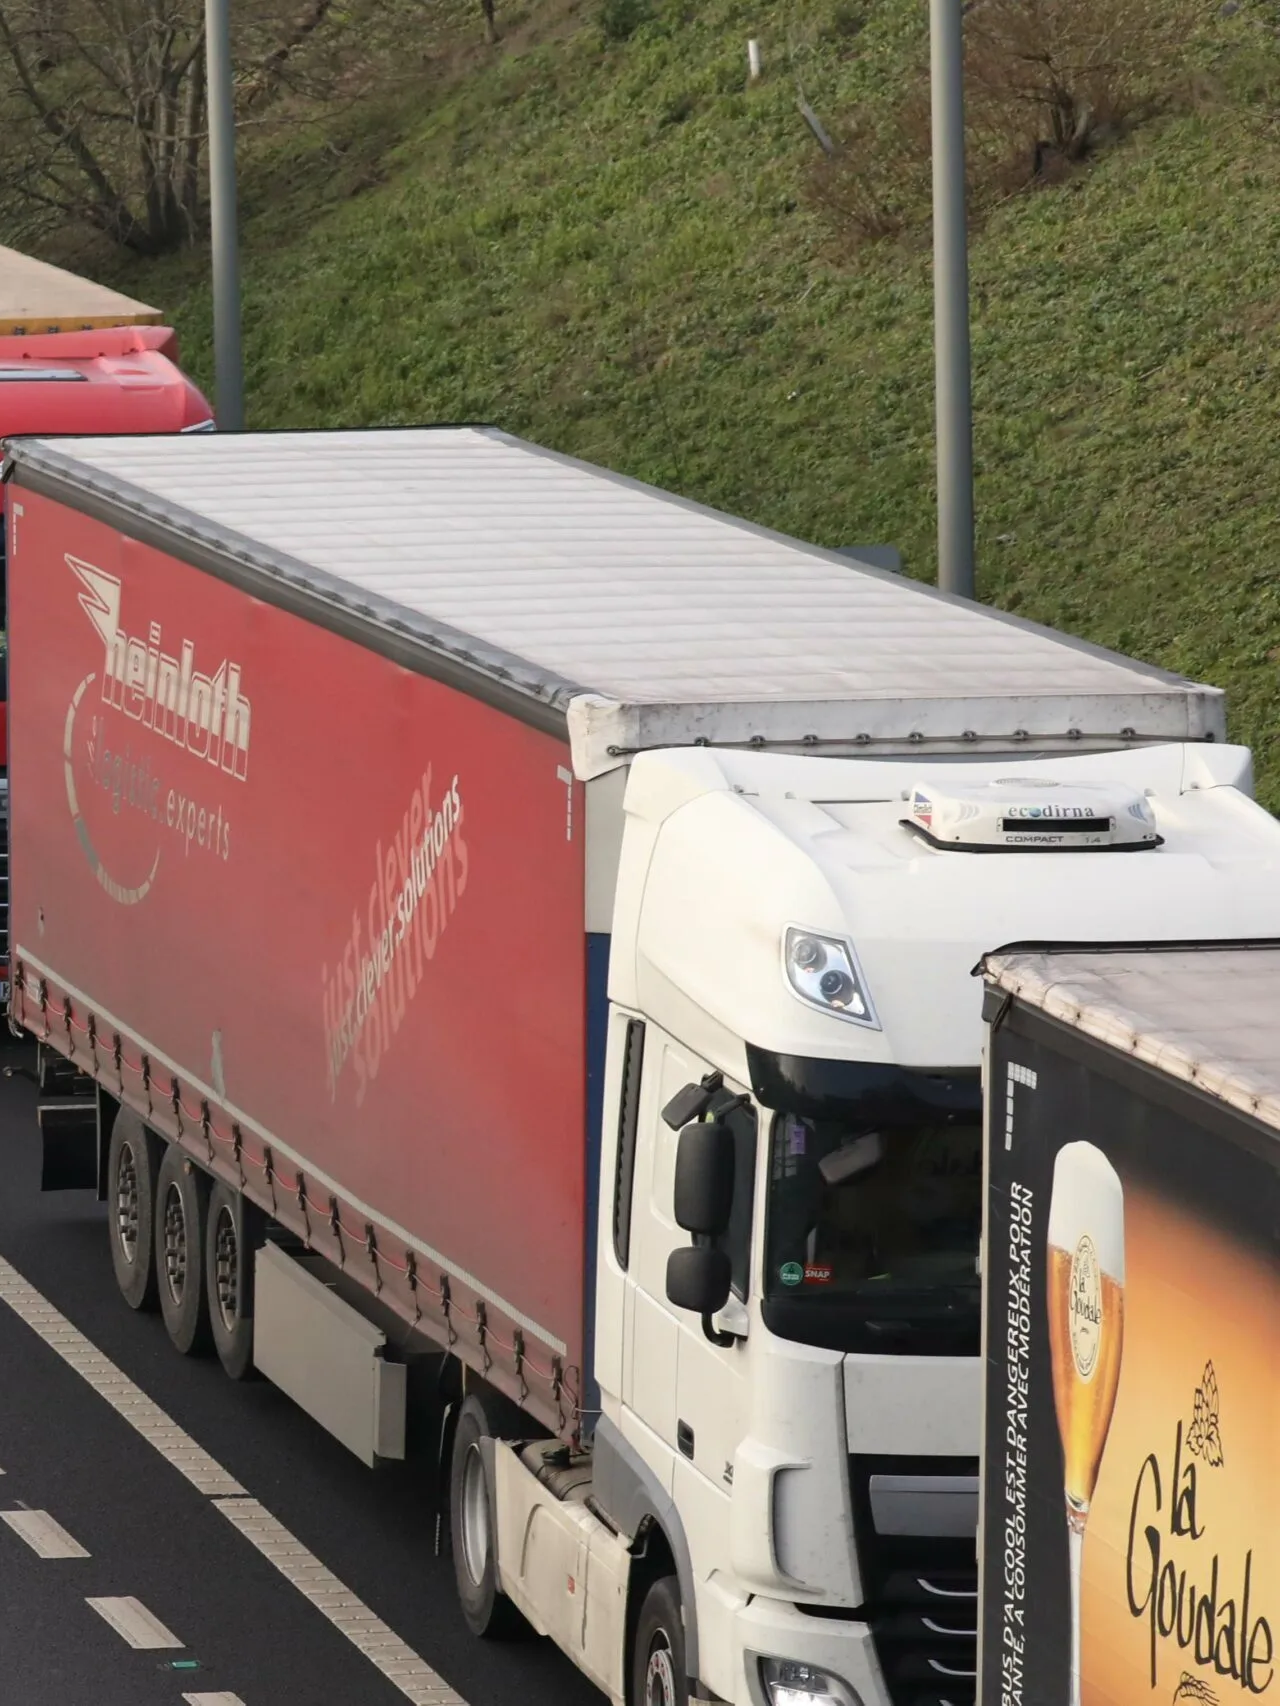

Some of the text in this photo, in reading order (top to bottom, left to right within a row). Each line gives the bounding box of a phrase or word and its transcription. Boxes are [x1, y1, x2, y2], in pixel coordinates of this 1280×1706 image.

[65, 553, 252, 783] heinloth
[1005, 835, 1064, 843] COMPACT
[1009, 1181, 1022, 1262] POUR
[804, 1270, 830, 1279] SNAP
[1018, 1187, 1034, 1359] MODERATION
[1070, 1275, 1102, 1326] Goudale
[1006, 1269, 1020, 1447] DANGEREUX
[1016, 1362, 1029, 1430] AVEC
[1005, 1451, 1017, 1504] EST
[1014, 1434, 1027, 1600] CONSOMMER
[1170, 1419, 1206, 1541] la
[1003, 1514, 1016, 1648] D'ALCOOL
[1126, 1453, 1274, 1694] Goudale
[1012, 1634, 1025, 1706] ANTE,
